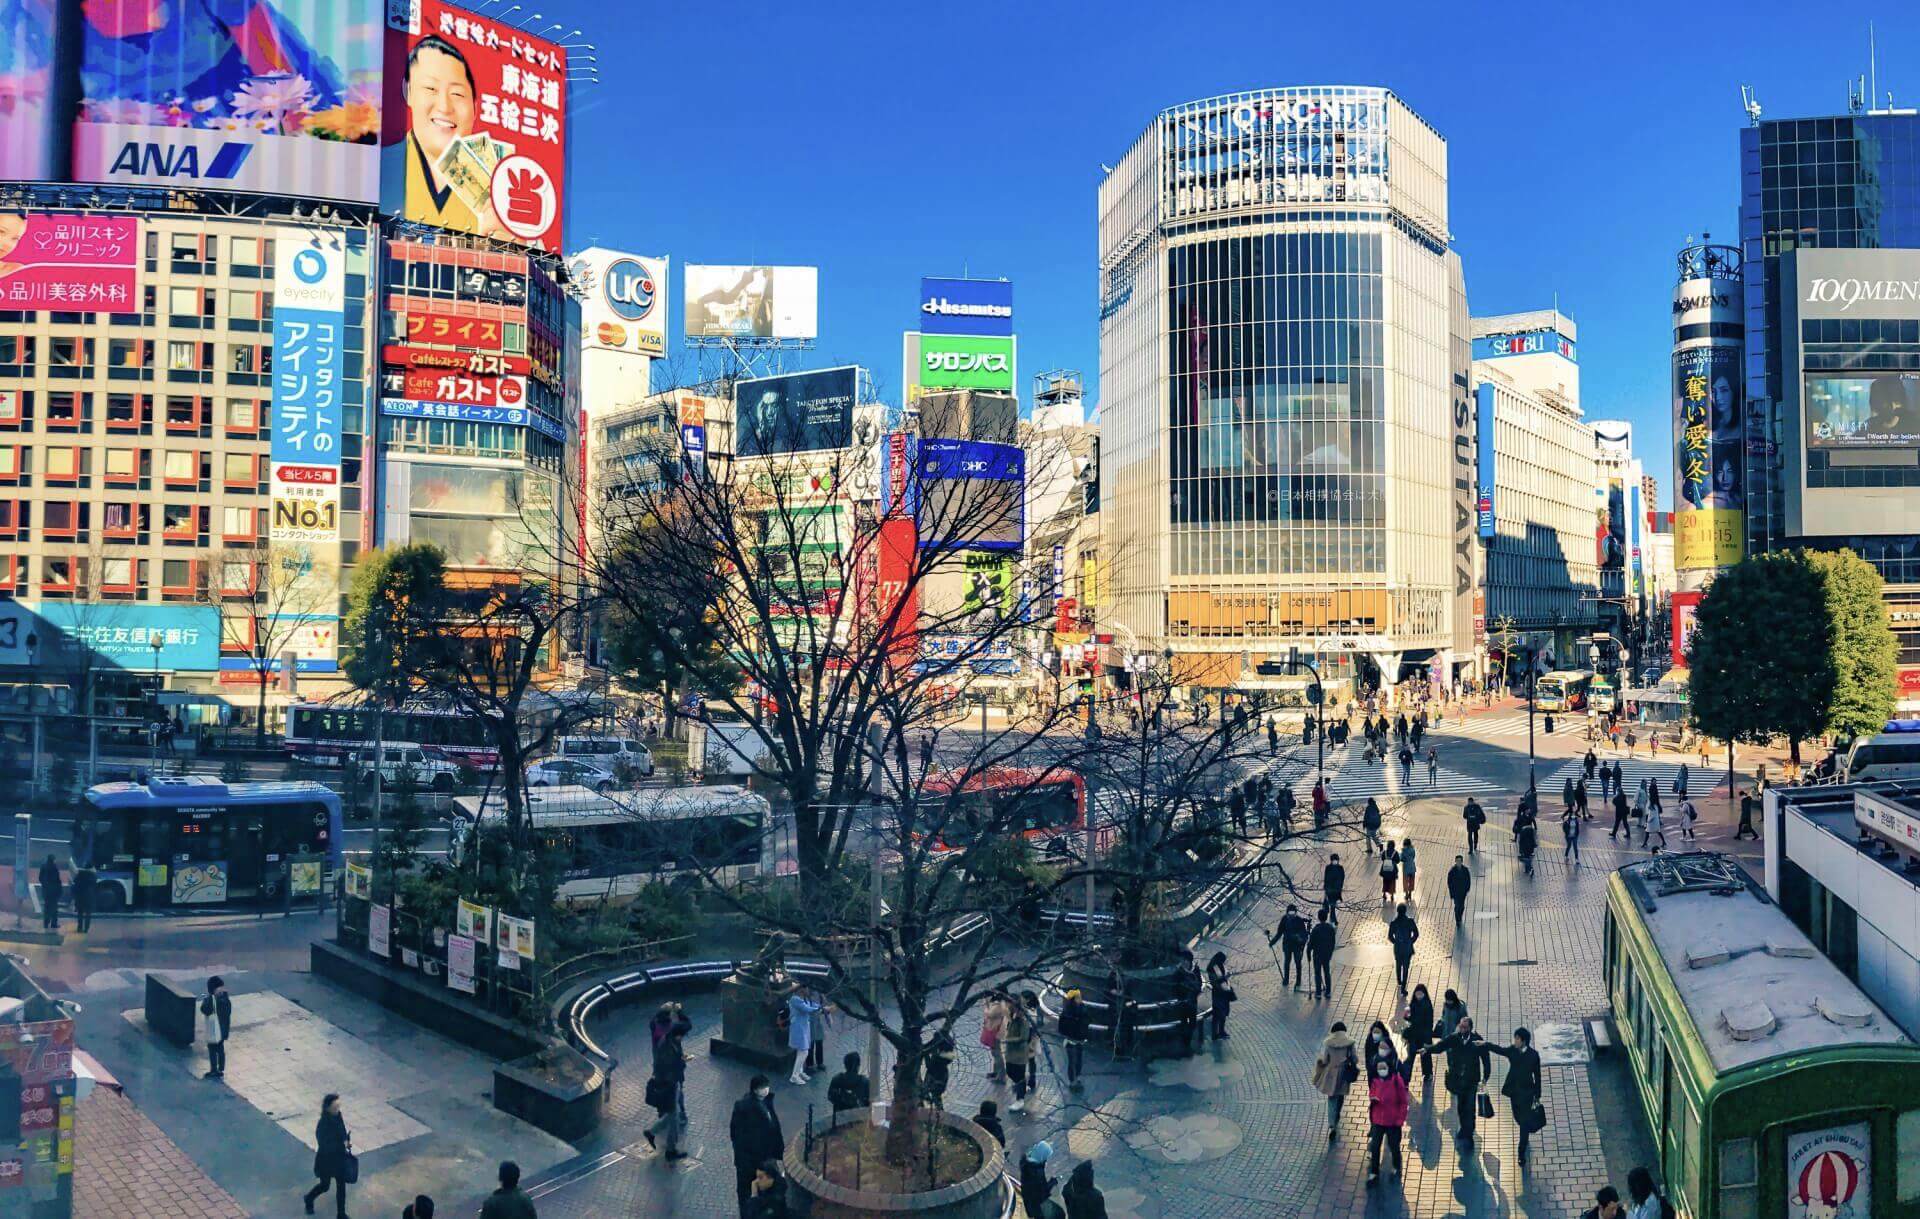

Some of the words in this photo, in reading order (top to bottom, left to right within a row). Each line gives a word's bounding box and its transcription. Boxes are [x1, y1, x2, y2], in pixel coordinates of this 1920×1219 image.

[502, 63, 560, 110] 東海道
[479, 94, 559, 144] 五拾三次
[109, 142, 199, 178] ANA
[508, 169, 545, 227] 当
[54, 225, 129, 241] 品川スキン
[55, 243, 121, 258] クリニック
[9, 281, 128, 303] 品川美容外科
[284, 286, 335, 302] eyecity
[1806, 279, 1920, 311] 109MEN
[921, 298, 1012, 317] Hisamitsu
[407, 317, 498, 341] プライス
[640, 334, 662, 345] VISA
[1493, 336, 1545, 355] SEIBU
[469, 354, 512, 374] ガスト
[926, 352, 1009, 372] サロンパス
[280, 321, 310, 451] アイシティ
[313, 323, 335, 452] コンタクトの
[436, 376, 492, 402] ガスト
[422, 403, 504, 419] 英会話イーオン
[1684, 375, 1710, 484] 奪い愛、冬
[962, 461, 987, 472] DHC
[1453, 369, 1471, 598] TSUTAYA
[274, 499, 336, 529] No.1
[1480, 486, 1491, 528] SEIBU
[1288, 597, 1331, 607] COFFEE
